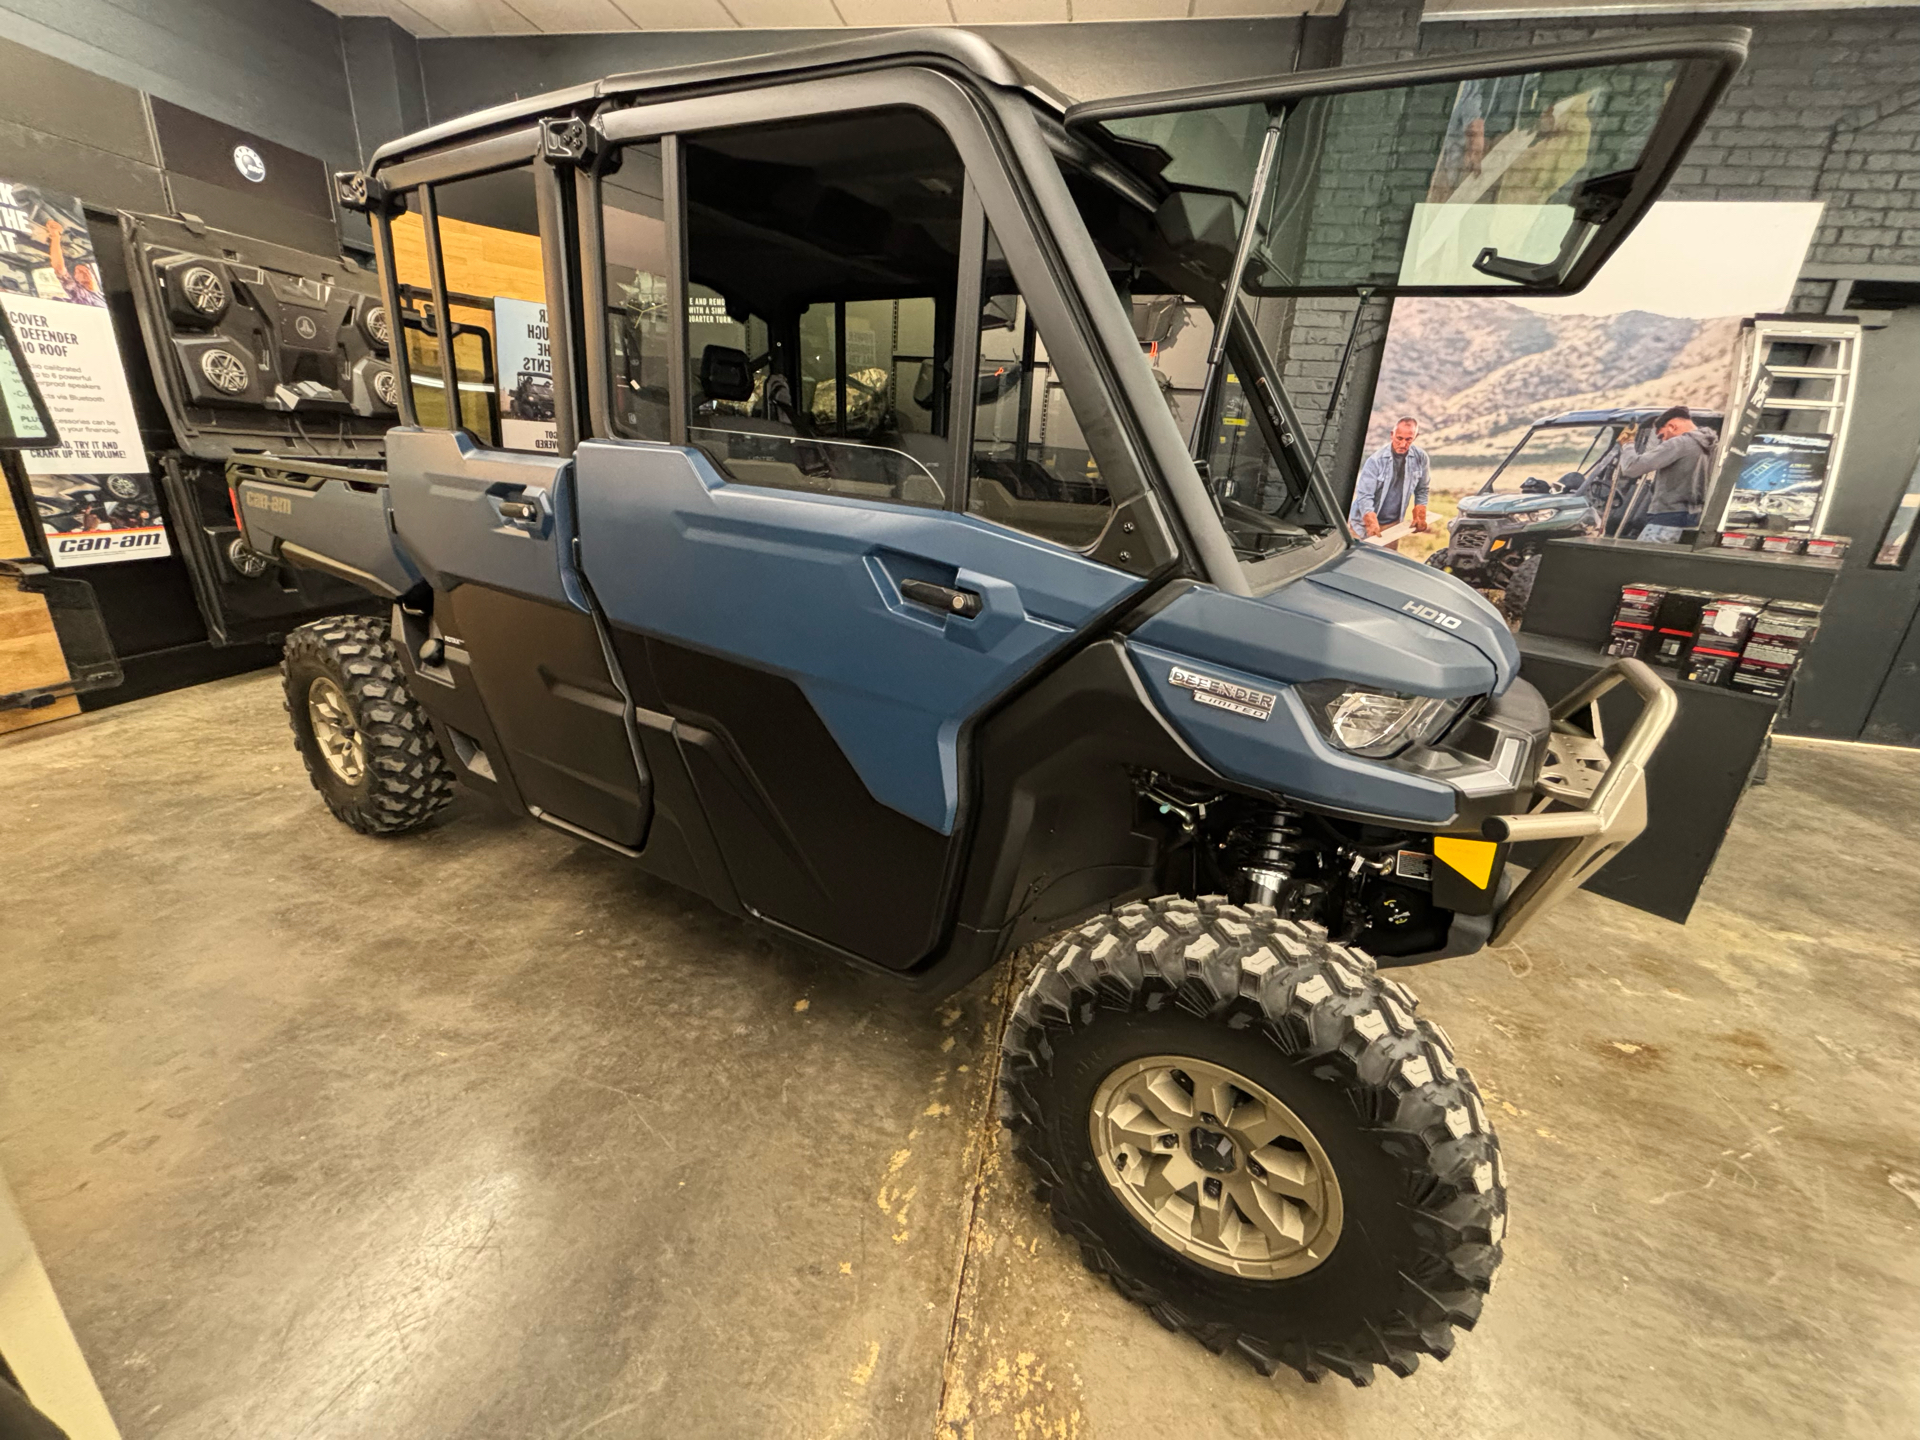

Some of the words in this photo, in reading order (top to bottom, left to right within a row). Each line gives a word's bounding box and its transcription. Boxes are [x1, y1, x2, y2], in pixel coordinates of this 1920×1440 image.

[695, 297, 707, 306] AND
[705, 306, 710, 314] A
[10, 311, 49, 327] COVER
[20, 326, 79, 345] DEFENDER
[38, 342, 68, 357] ROOF
[44, 364, 82, 373] calibrated
[58, 373, 92, 382] powerful
[68, 382, 101, 390] speakers
[69, 394, 105, 402] Bluetooth
[74, 441, 90, 450] TRY
[91, 441, 100, 450] IT
[102, 441, 119, 450] AND
[30, 449, 61, 459] CRANK
[62, 450, 74, 458] UP
[75, 450, 91, 459] THE
[92, 450, 127, 459] VOLUME!
[246, 491, 292, 515] can-am
[59, 533, 161, 552] can-am
[1402, 600, 1462, 630] HD10
[1172, 671, 1274, 708] DEFENDER
[1198, 694, 1265, 718] LIMITED
